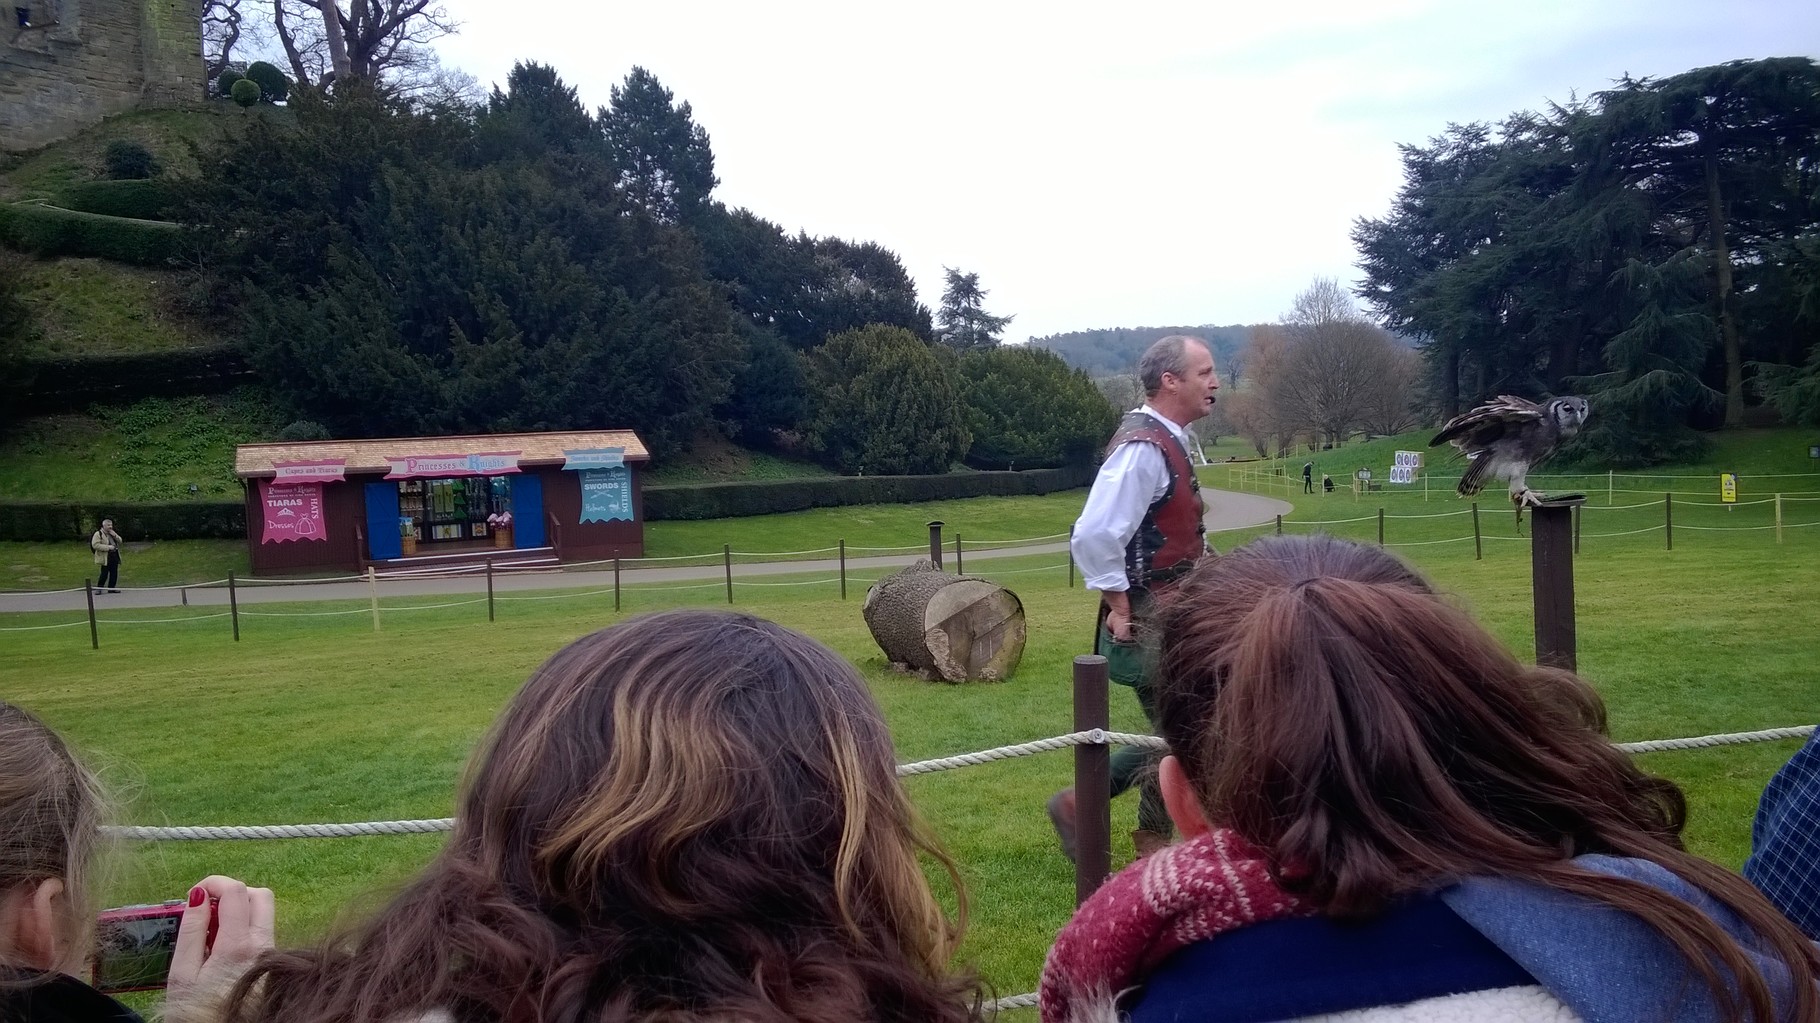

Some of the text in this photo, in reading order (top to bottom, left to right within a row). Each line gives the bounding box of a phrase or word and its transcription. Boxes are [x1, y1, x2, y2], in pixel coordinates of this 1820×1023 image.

[405, 458, 456, 473] Princesses
[467, 455, 505, 473] Knights
[584, 482, 619, 491] SWORDS
[267, 499, 303, 507] TIARAS
[621, 482, 629, 513] SHIELDS
[311, 498, 319, 519] HATS
[268, 520, 295, 529] Dresses
